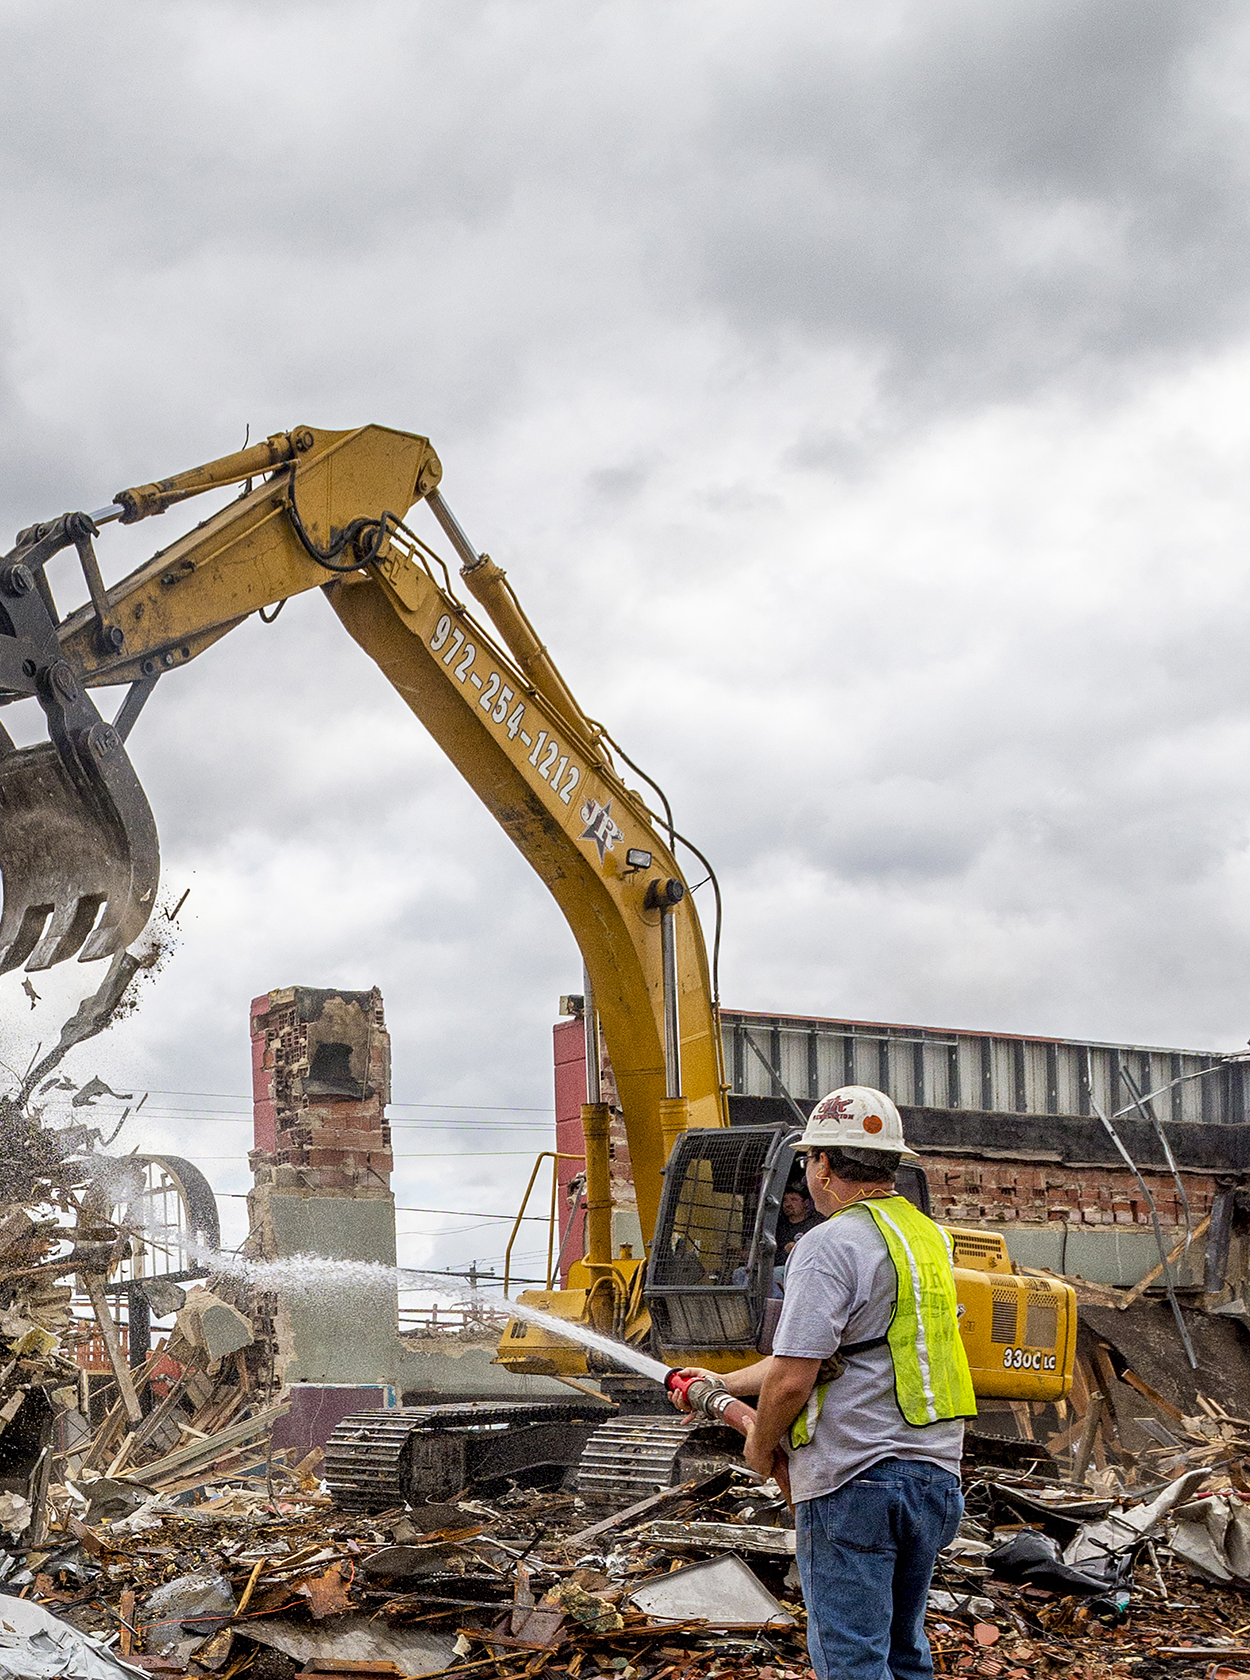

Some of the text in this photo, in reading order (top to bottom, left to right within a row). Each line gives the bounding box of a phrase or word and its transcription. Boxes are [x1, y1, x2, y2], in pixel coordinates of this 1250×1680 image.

[430, 613, 581, 806] 972-254-1212
[1002, 1346, 1057, 1371] 330C LC
